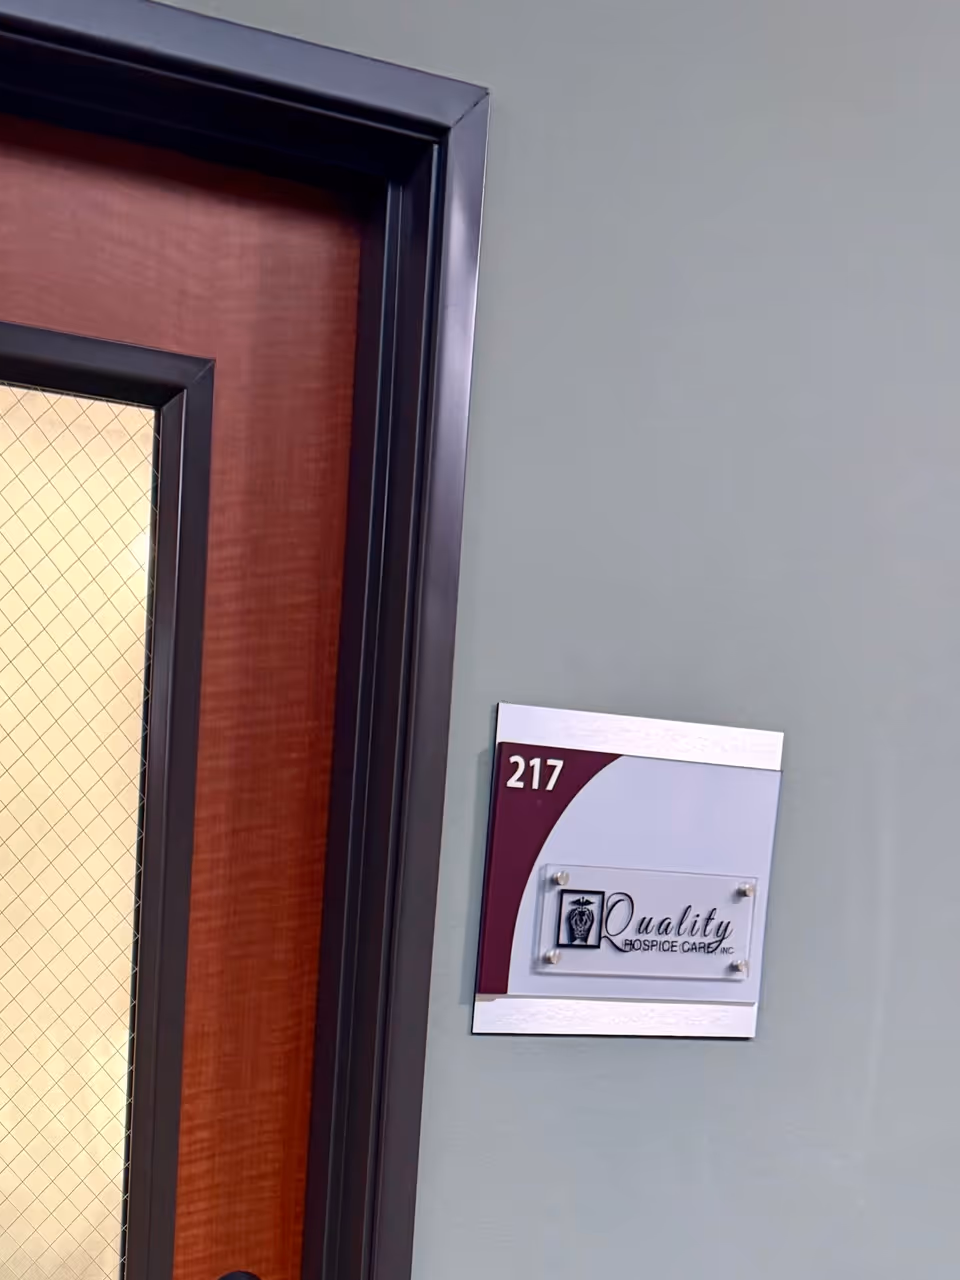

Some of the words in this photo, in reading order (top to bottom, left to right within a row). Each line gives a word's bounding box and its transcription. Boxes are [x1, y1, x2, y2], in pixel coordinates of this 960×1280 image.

[505, 755, 564, 791] 217
[601, 892, 733, 953] Quality
[624, 939, 678, 953] HOSPICE
[720, 946, 735, 955] INC
